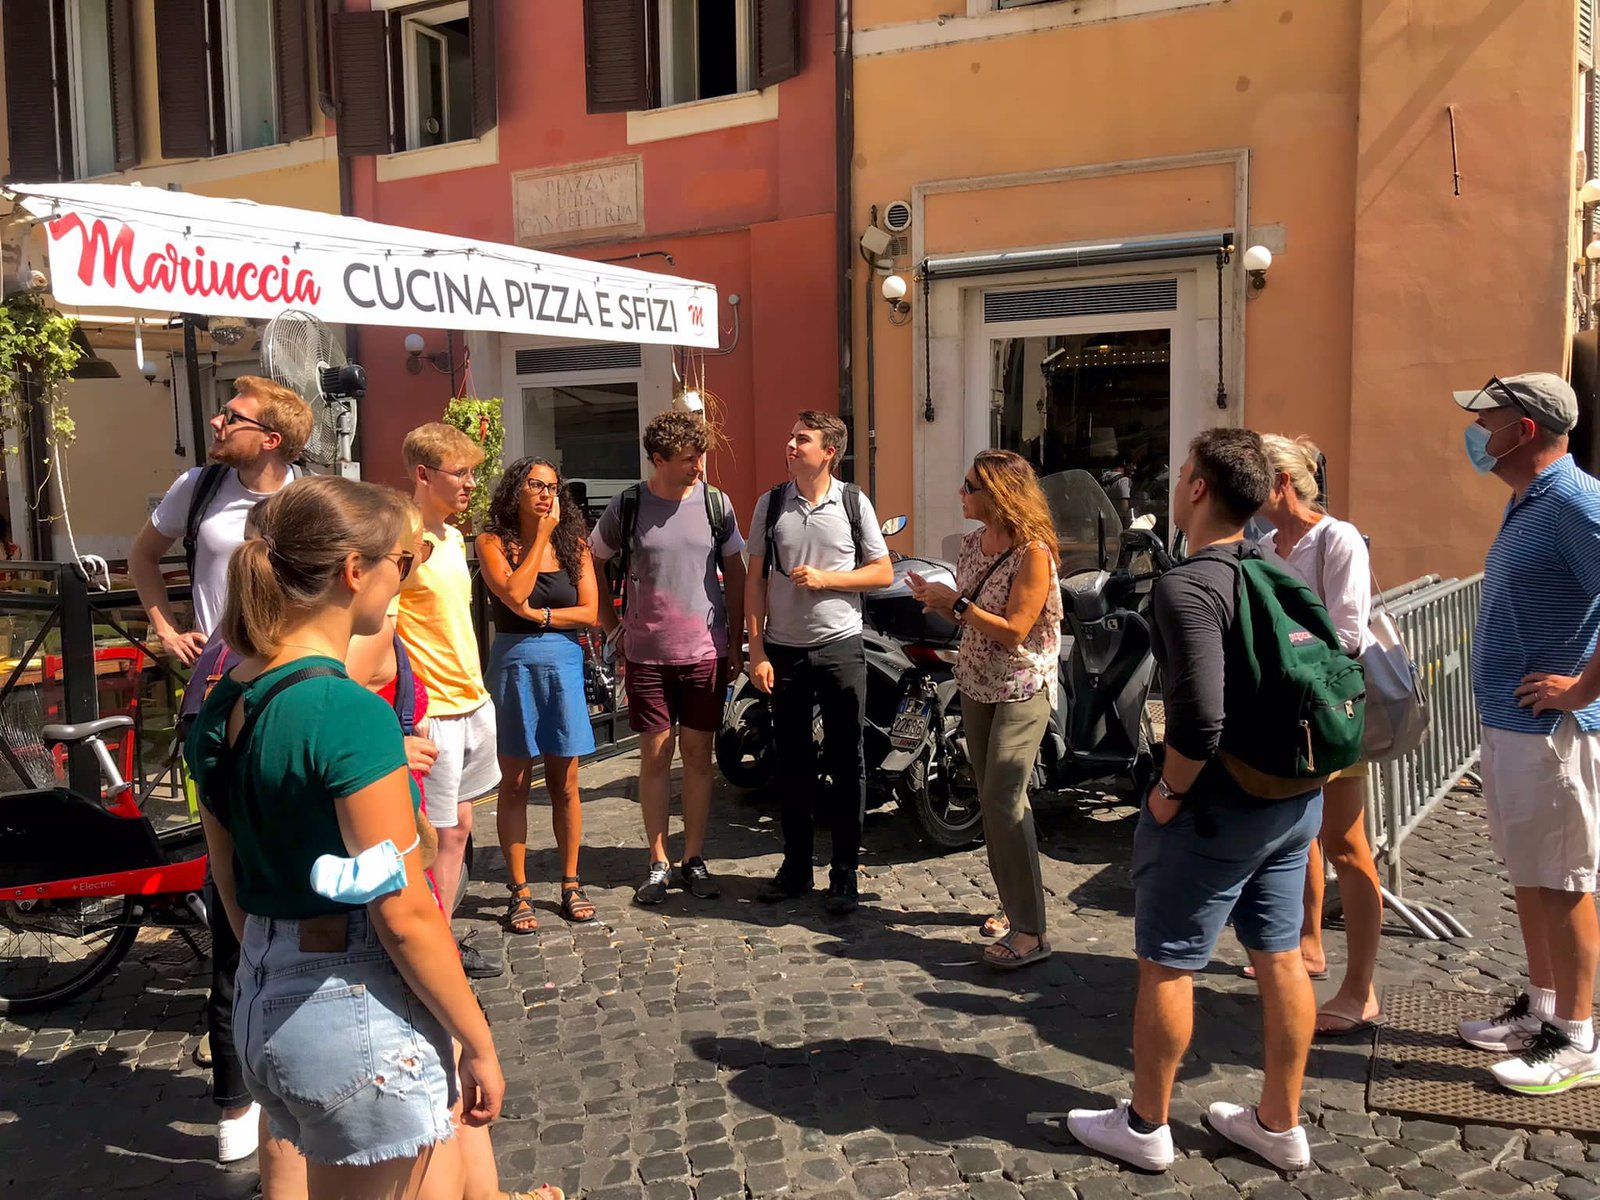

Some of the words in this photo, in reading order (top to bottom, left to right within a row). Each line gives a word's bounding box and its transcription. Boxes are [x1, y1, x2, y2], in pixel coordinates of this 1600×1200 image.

[545, 173, 606, 196] PIAZZA
[49, 212, 321, 305] Mariuccia
[343, 262, 501, 317] CUCINA
[505, 279, 594, 326] PIZZA
[596, 291, 614, 328] E
[619, 295, 678, 333] SFIZI
